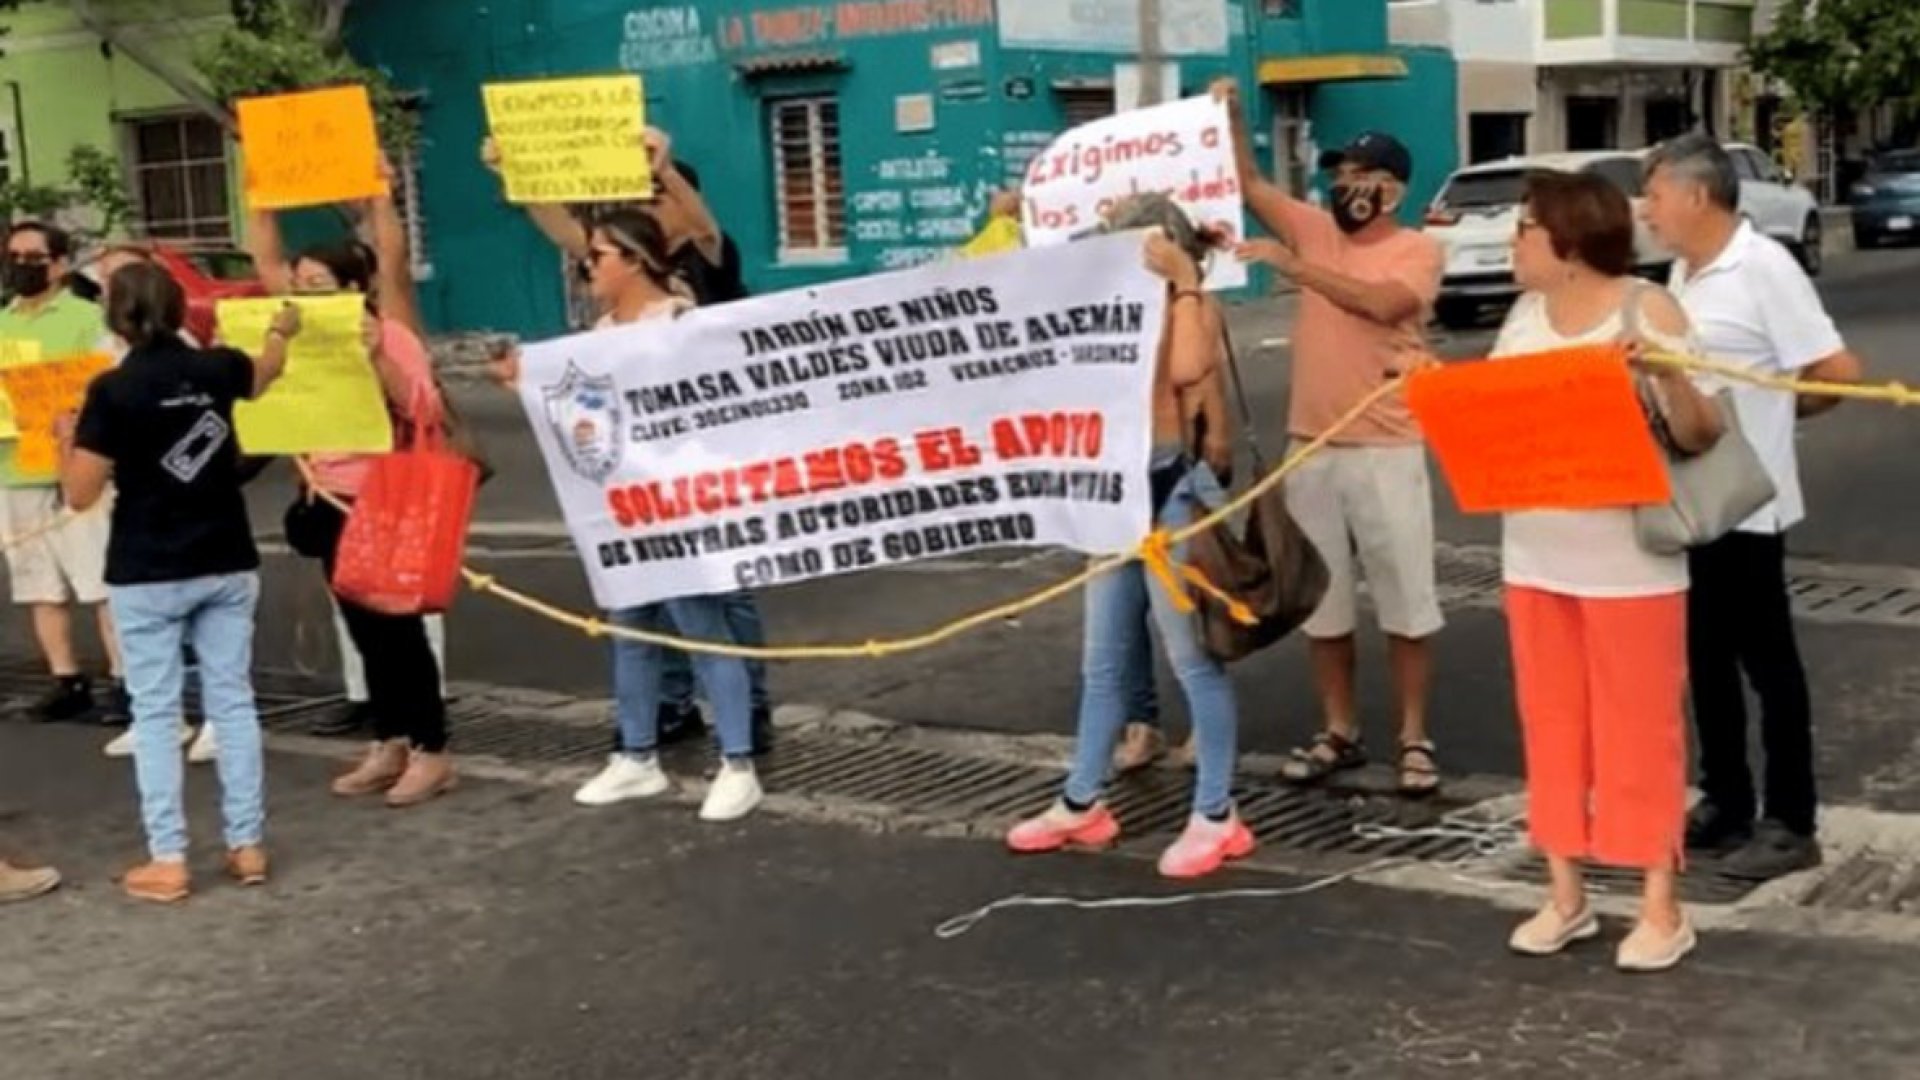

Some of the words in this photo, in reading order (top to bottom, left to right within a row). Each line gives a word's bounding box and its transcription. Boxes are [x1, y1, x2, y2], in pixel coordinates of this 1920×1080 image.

[1029, 132, 1184, 185] Exigimos
[1200, 126, 1219, 149] a
[1028, 198, 1079, 229] los
[624, 369, 743, 417] TOMASA
[873, 326, 970, 367] VIUDA
[975, 320, 1020, 351] DE
[1024, 294, 1144, 343] ALEMÁN
[740, 310, 849, 356] JARDÍN
[853, 304, 898, 335] DE
[899, 286, 998, 326] NIÑOS
[837, 375, 892, 401] ZONA
[893, 368, 928, 391] 102
[951, 348, 1058, 382] VERACRUZ
[608, 437, 907, 528] SOLICITAMOS
[914, 426, 981, 472] EL
[991, 411, 1103, 460] APOYO
[598, 539, 631, 569] DE
[632, 516, 766, 563] NUESTRAS
[776, 475, 1000, 541] AUTORIDADES
[734, 547, 823, 589] COMO
[830, 537, 876, 571] DE
[882, 512, 1036, 561] GOBIERNO
